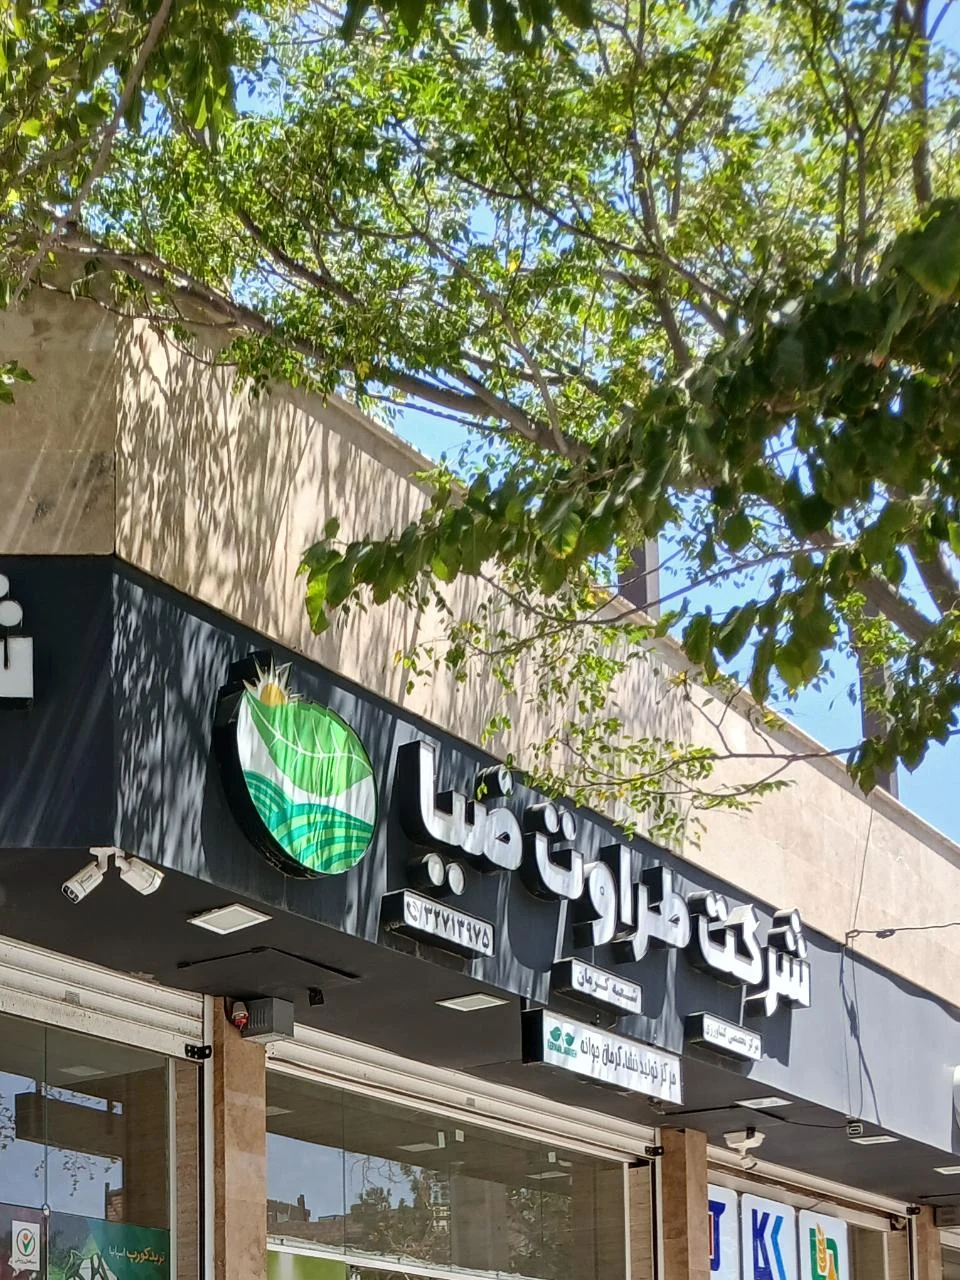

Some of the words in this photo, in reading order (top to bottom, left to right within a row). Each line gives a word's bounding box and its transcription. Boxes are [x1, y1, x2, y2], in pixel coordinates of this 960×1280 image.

[425, 905, 490, 948] ۳۲۷۱۳۹۷۵
[534, 802, 691, 962] طراوت
[698, 890, 811, 1017] شرکت
